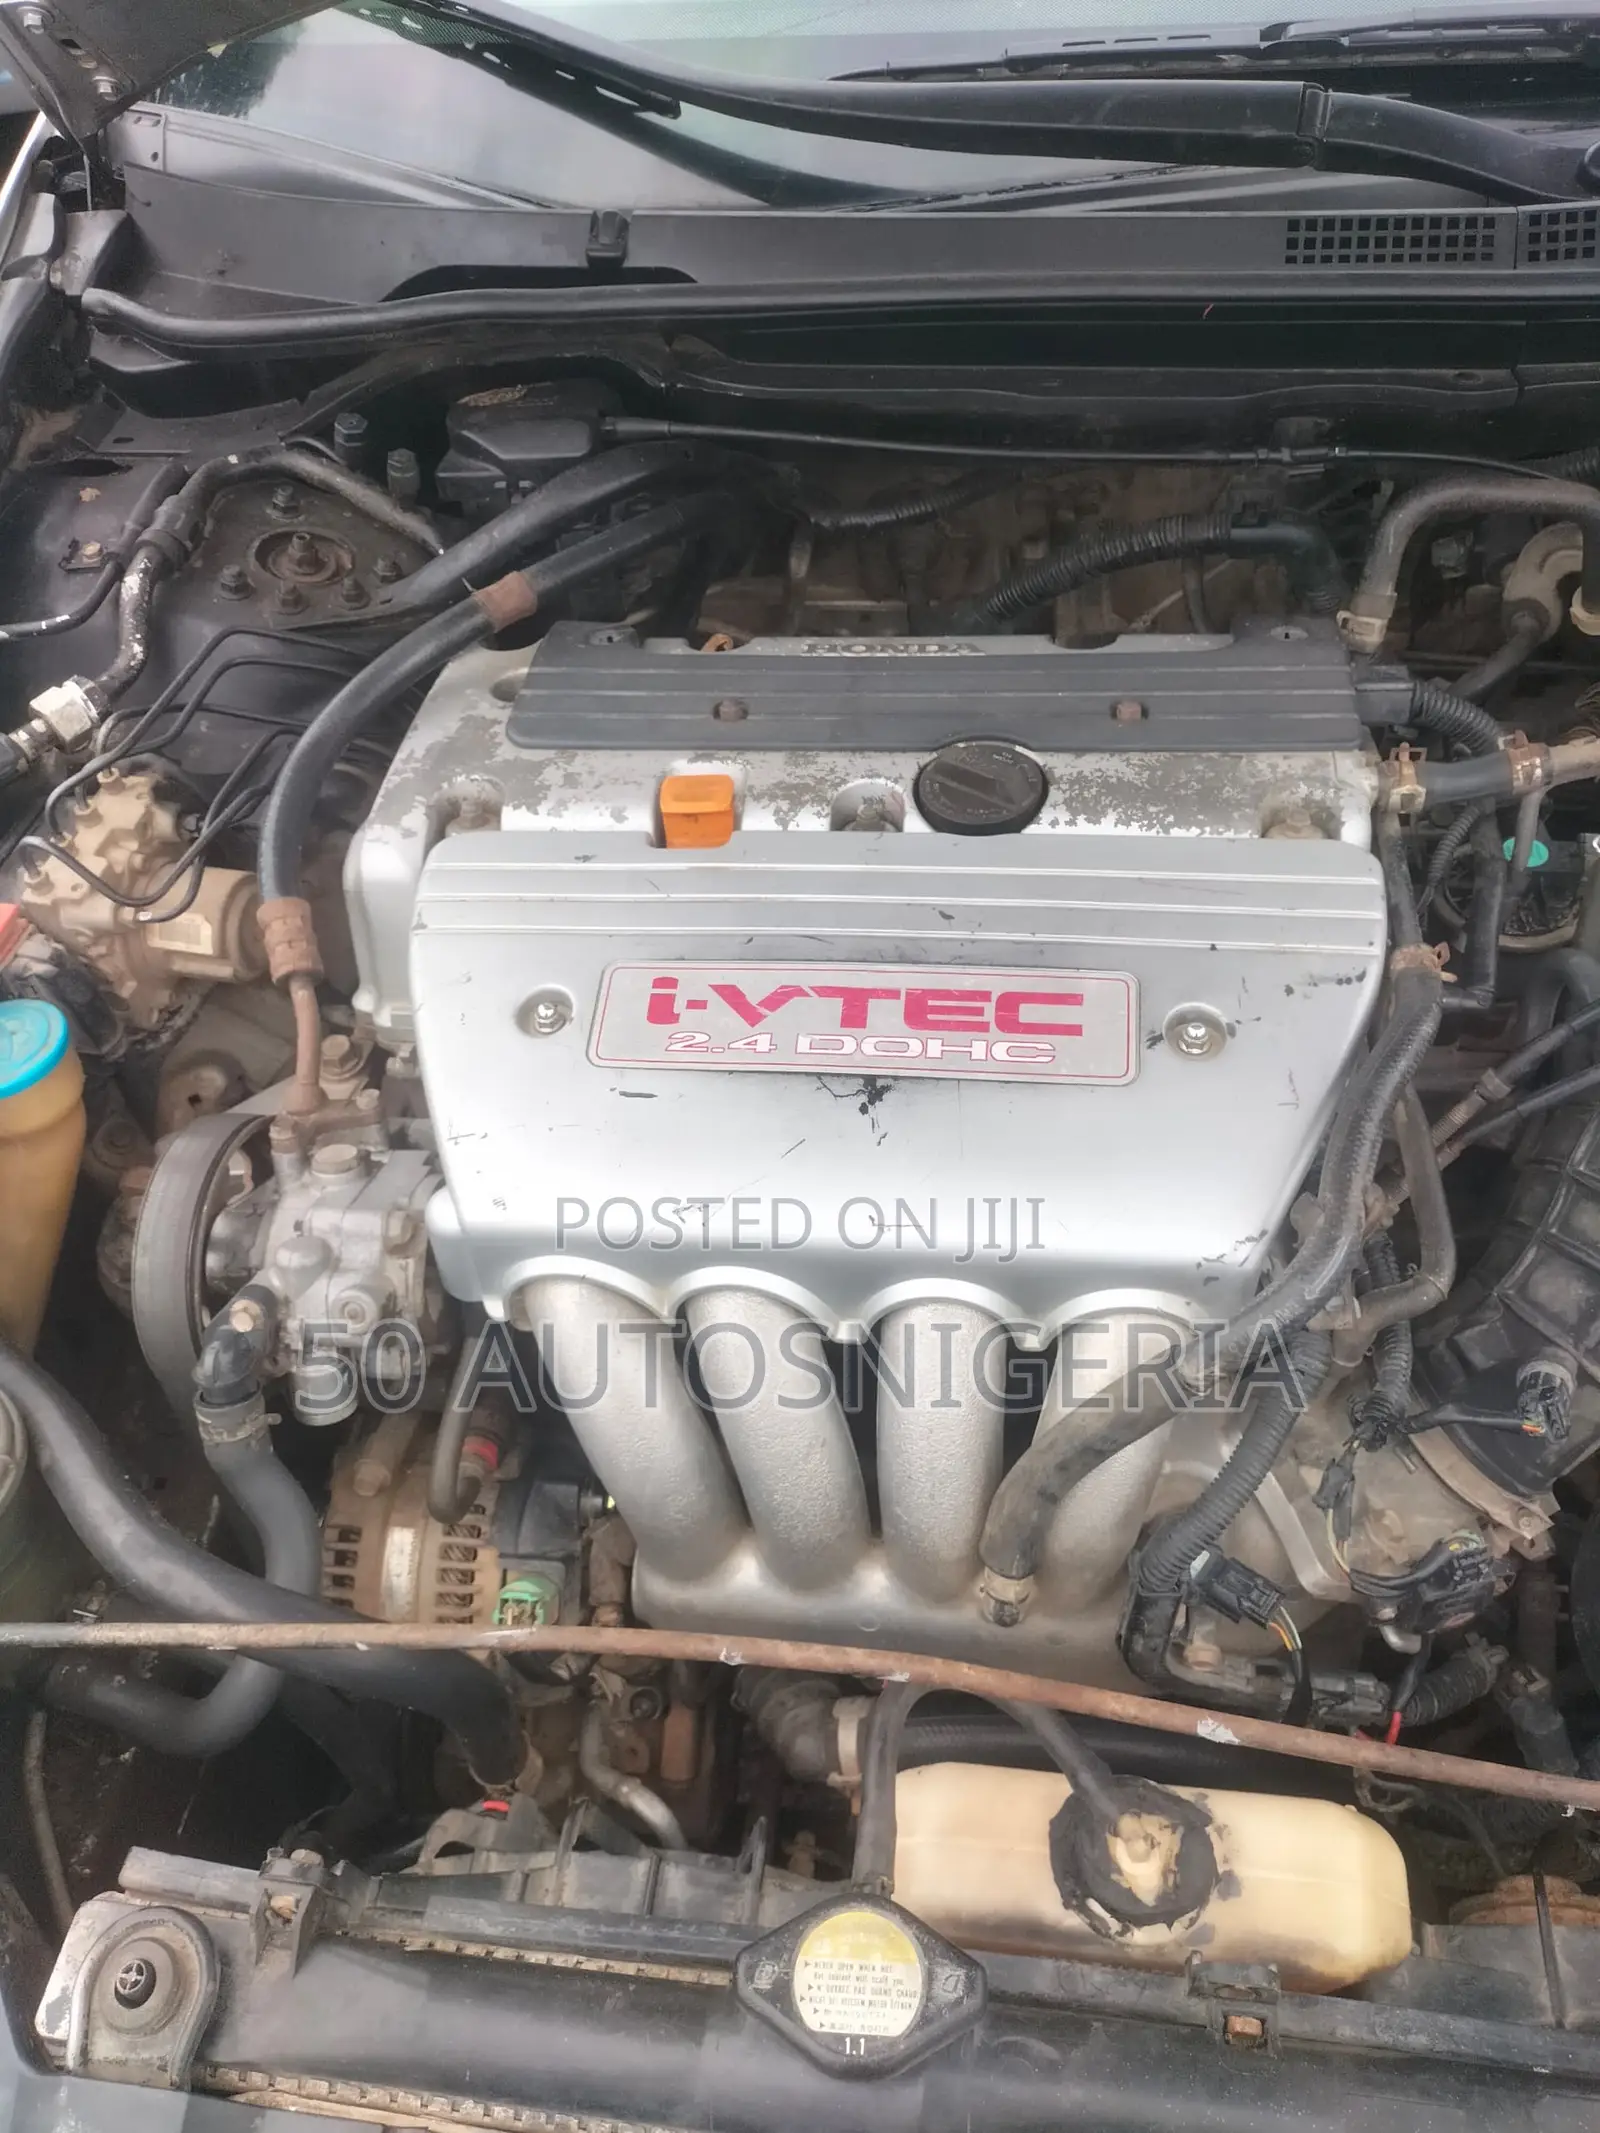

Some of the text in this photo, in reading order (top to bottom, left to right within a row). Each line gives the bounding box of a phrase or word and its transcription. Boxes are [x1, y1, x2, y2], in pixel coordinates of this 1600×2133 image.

[800, 640, 986, 656] HONDA
[646, 976, 1084, 1036] i-VTEC
[664, 1030, 1057, 1064] 2.4 DOHC
[844, 2037, 866, 2056] 1.1
